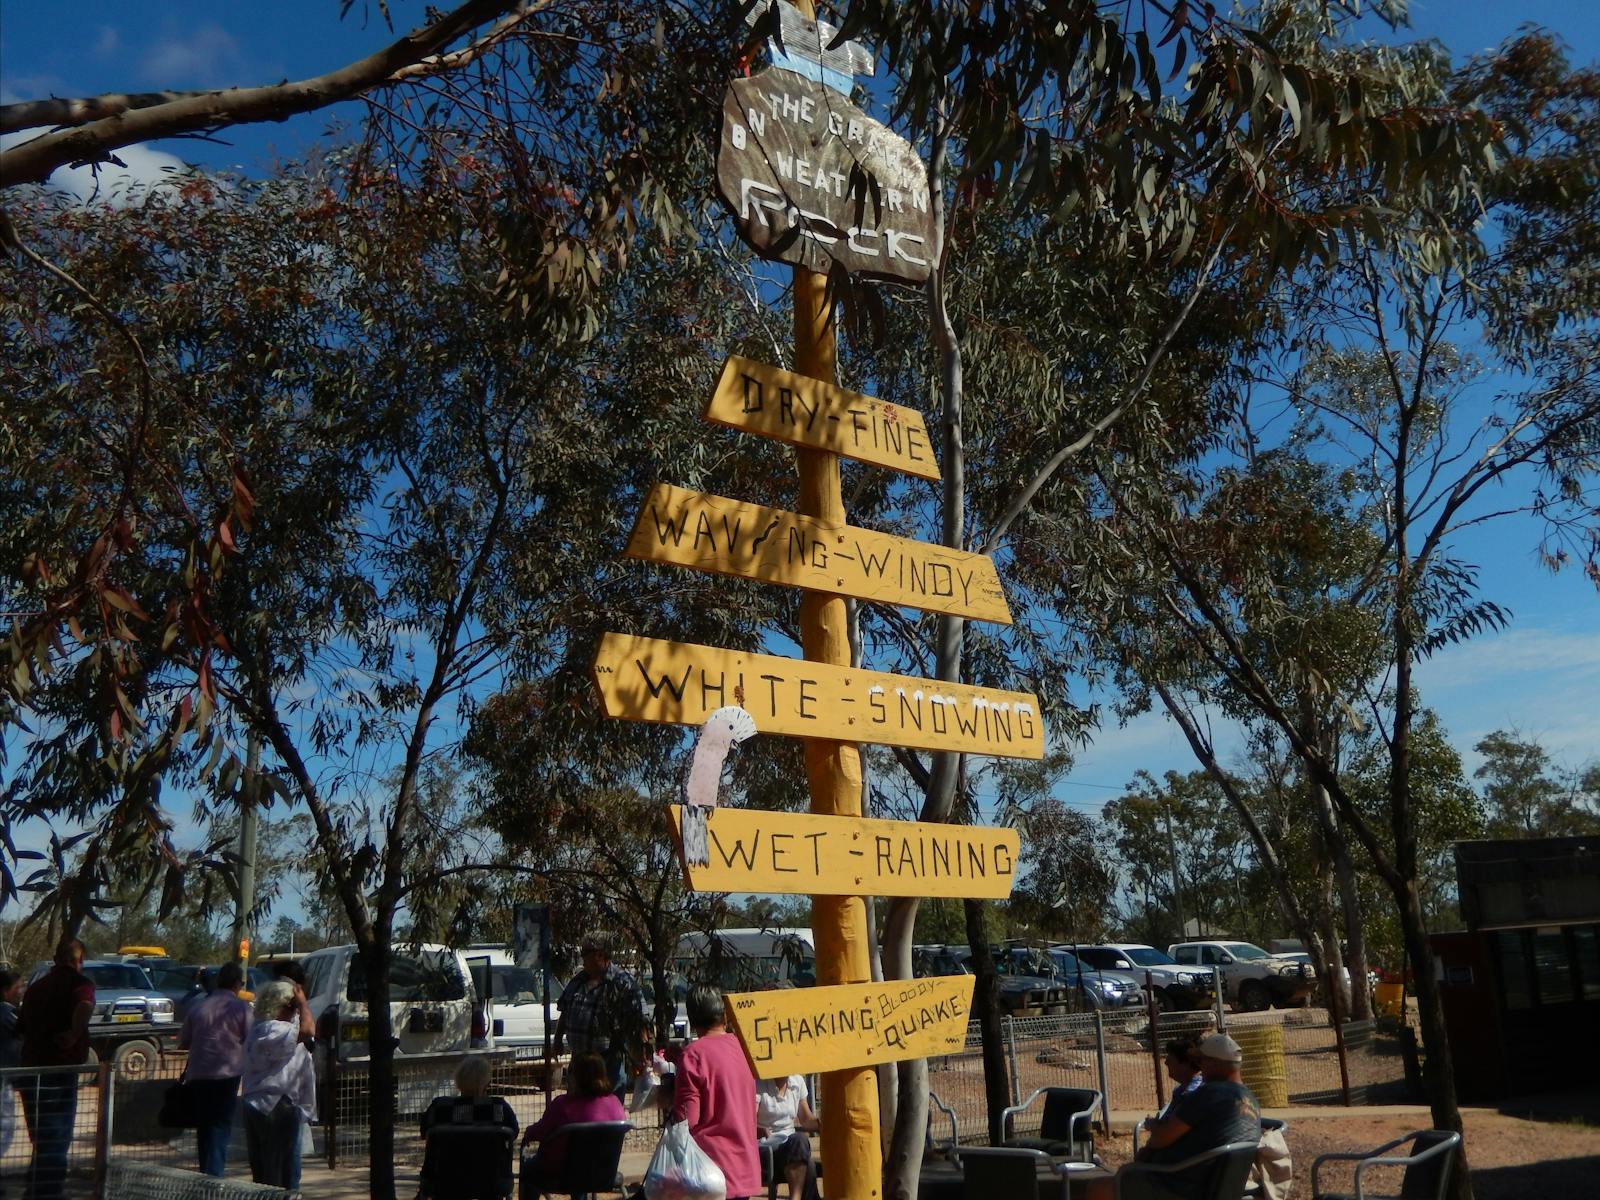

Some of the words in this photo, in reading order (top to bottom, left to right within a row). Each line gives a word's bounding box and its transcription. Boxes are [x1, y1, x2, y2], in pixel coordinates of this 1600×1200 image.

[732, 108, 766, 151] ON
[769, 93, 815, 124] THE
[776, 151, 904, 214] WEATR
[740, 178, 928, 266] ROCK
[754, 1003, 874, 1062] SHAKING
